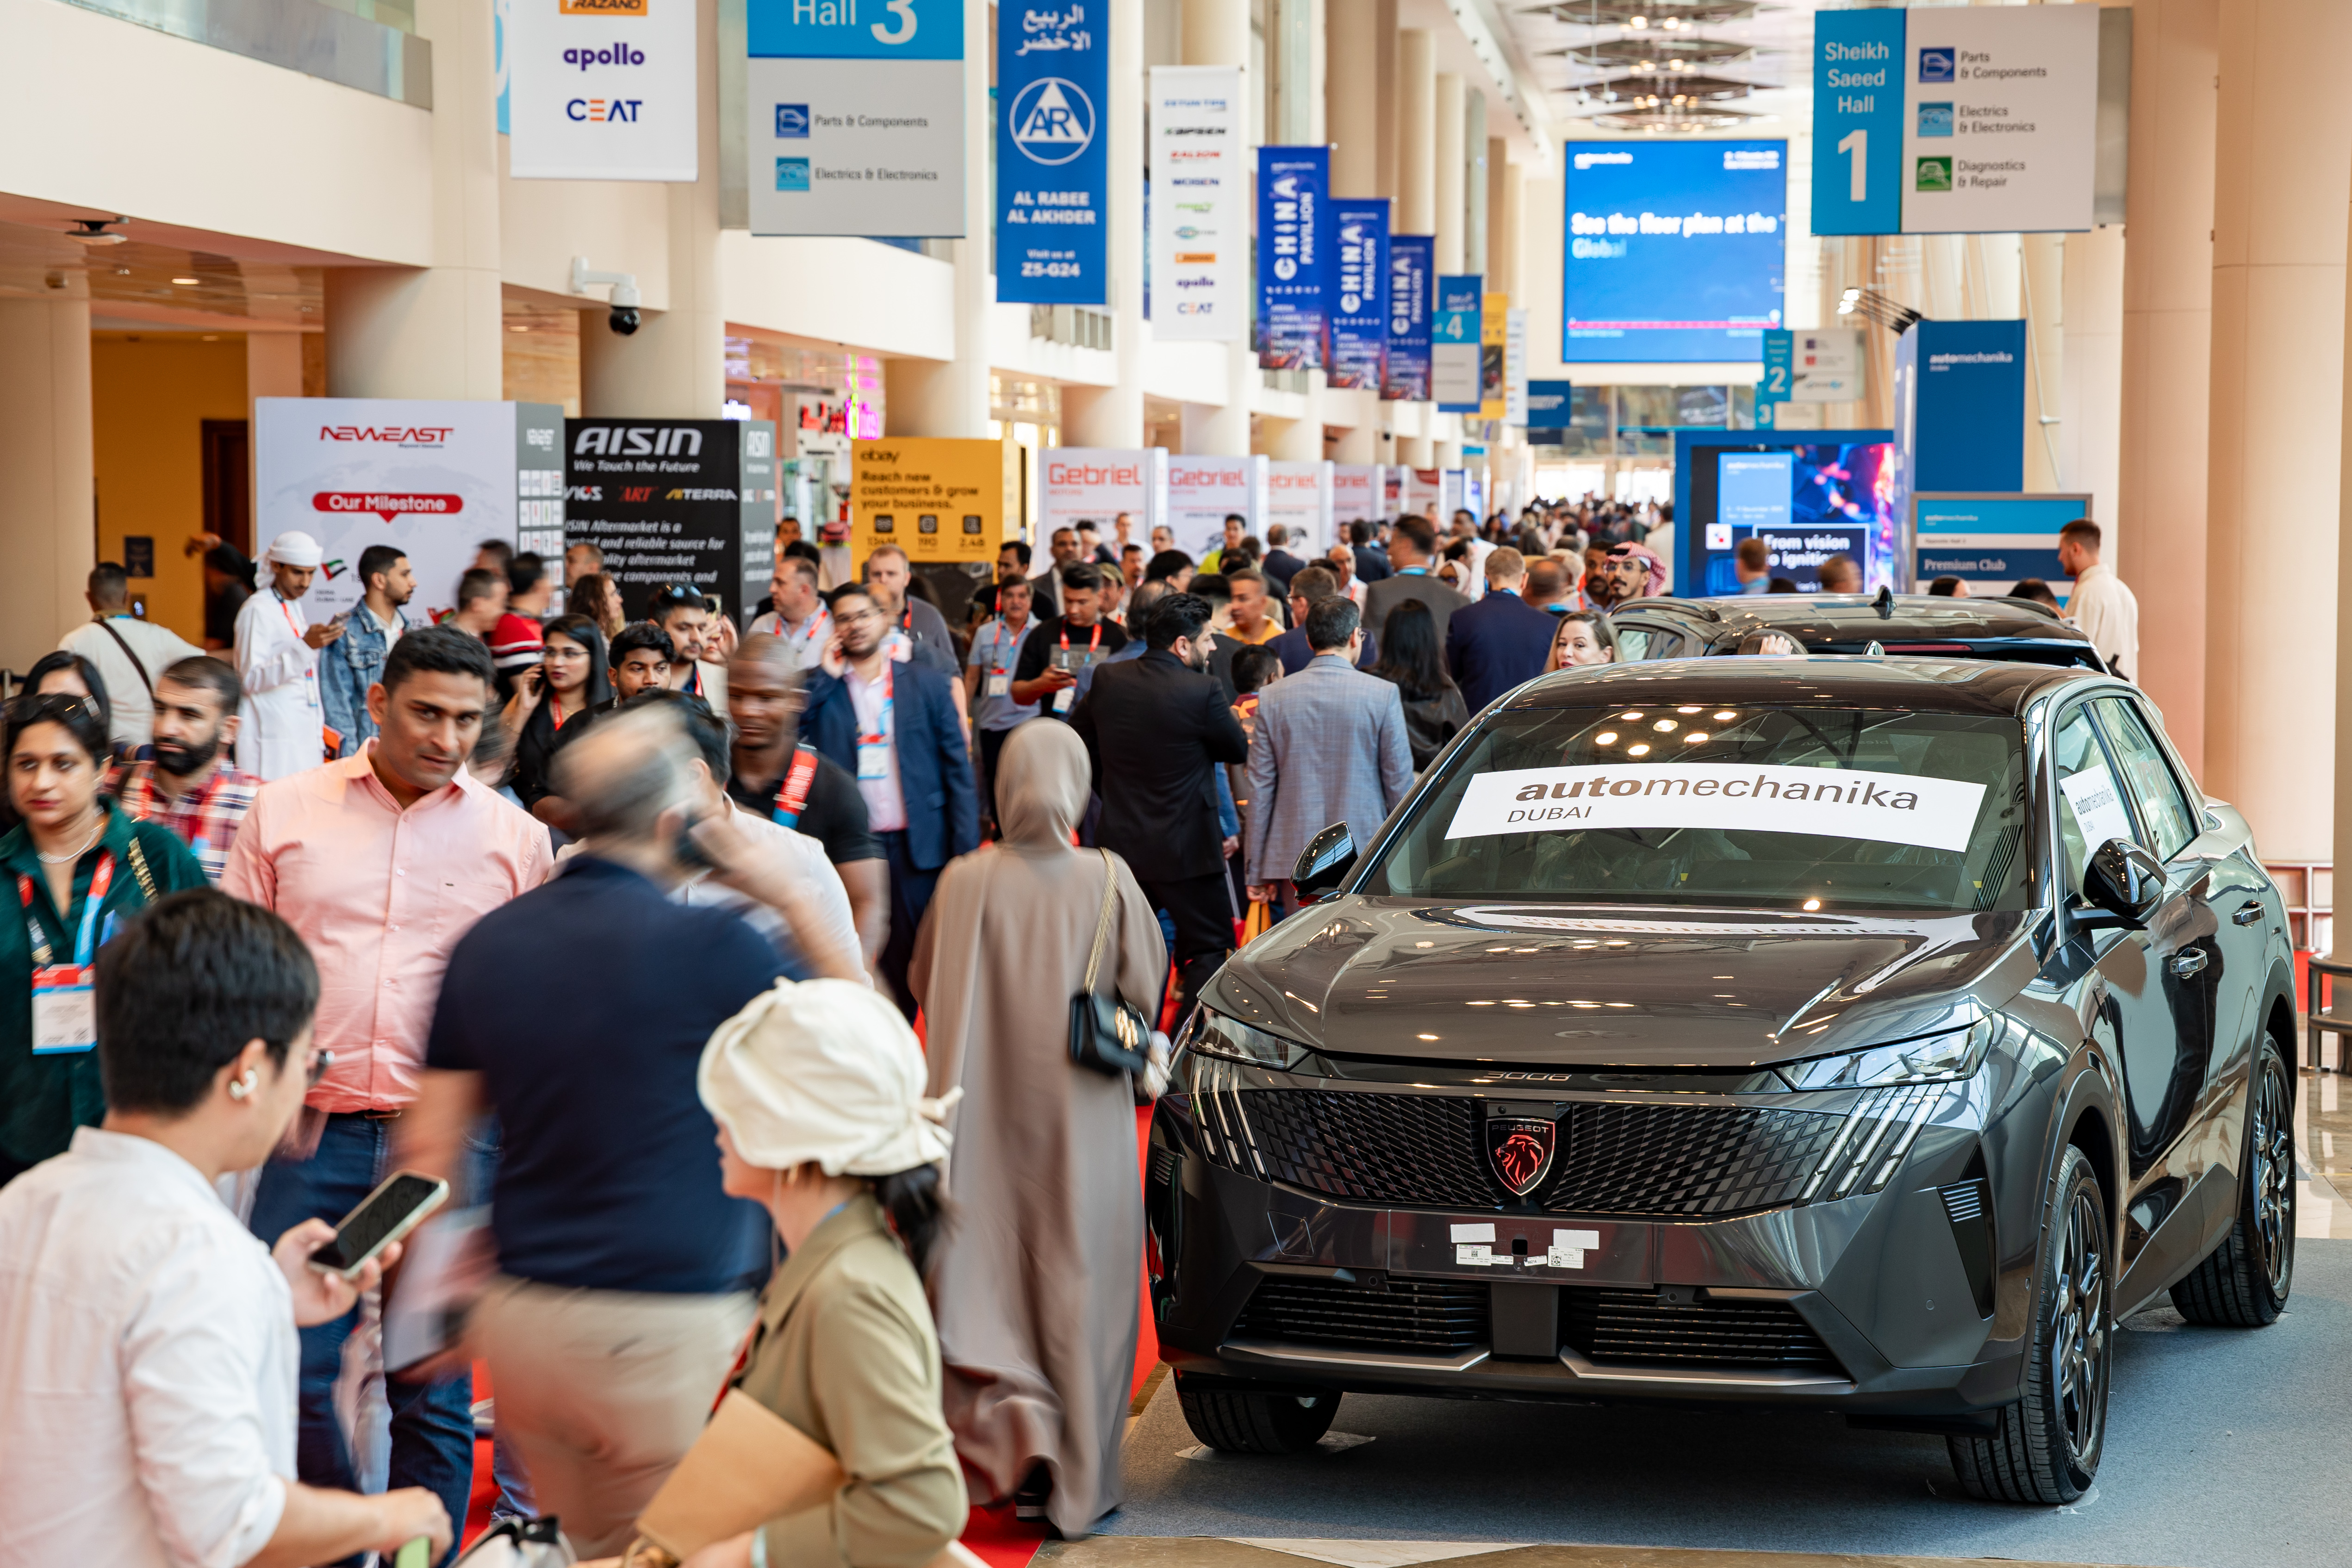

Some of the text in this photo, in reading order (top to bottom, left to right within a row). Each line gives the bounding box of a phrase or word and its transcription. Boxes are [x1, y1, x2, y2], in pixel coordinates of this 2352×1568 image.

[793, 0, 917, 44] Hall 3
[563, 43, 645, 71] apollo
[1825, 42, 1889, 61] Sheikh
[1961, 51, 1990, 63] Parts
[1828, 68, 1885, 88] Saeed
[1960, 66, 2047, 79] & Components
[566, 99, 642, 122] CEAT
[1838, 95, 1874, 113] Hall
[1960, 105, 2008, 117] Electrics
[815, 115, 929, 128] Parts & Components
[1028, 108, 1072, 137] AR
[1960, 121, 2035, 133] & Electronics
[815, 168, 938, 180] Electrics & Electronics
[1838, 129, 1867, 202] 1
[1958, 159, 2025, 172] Diagnostics
[1958, 175, 2007, 189] & Repair
[1013, 190, 1090, 206] AL RABEE
[1007, 209, 1096, 224] AL AKHDER
[1572, 212, 1606, 235] See
[1607, 213, 1638, 235] the
[1683, 212, 1724, 238] plan
[1724, 214, 1745, 234] at
[1746, 212, 1778, 234] the
[1274, 177, 1297, 280] CHINA
[1300, 192, 1314, 265] PAVILION
[1572, 237, 1627, 259] Global
[1341, 224, 1362, 313] CHINA
[1363, 238, 1376, 301] PAVILION
[1391, 256, 1412, 335] CHINA
[1446, 314, 1463, 340] 4
[1930, 351, 2013, 365] automechanika
[1768, 366, 1786, 393] 2
[574, 427, 703, 456] AISIN
[860, 448, 900, 464] ebay
[574, 459, 700, 473] We Touch the Future
[1049, 463, 1142, 486] Gebriel
[861, 471, 931, 482] Reach new
[1170, 467, 1246, 487] Gebriel
[1269, 472, 1318, 489] ebriel
[861, 485, 979, 498] customers & grow
[329, 495, 447, 512] Our Milestone
[861, 499, 954, 511] your business.
[566, 519, 682, 533] ISIN Aftermarket is a
[600, 536, 624, 549] and
[624, 537, 668, 549] reliable
[669, 539, 707, 550] source
[707, 537, 726, 550] for
[1763, 534, 1850, 550] From vision
[628, 553, 696, 566] aftermarket
[1924, 558, 2006, 572] Premium Club
[623, 571, 693, 585] components
[693, 570, 718, 583] and
[1515, 774, 1919, 812] automechanika
[2075, 784, 2114, 815] automechanika
[1507, 806, 1593, 825] DUBAI
[1483, 1071, 1572, 1082] 3008
[1492, 1125, 1549, 1133] PEUGEOT
